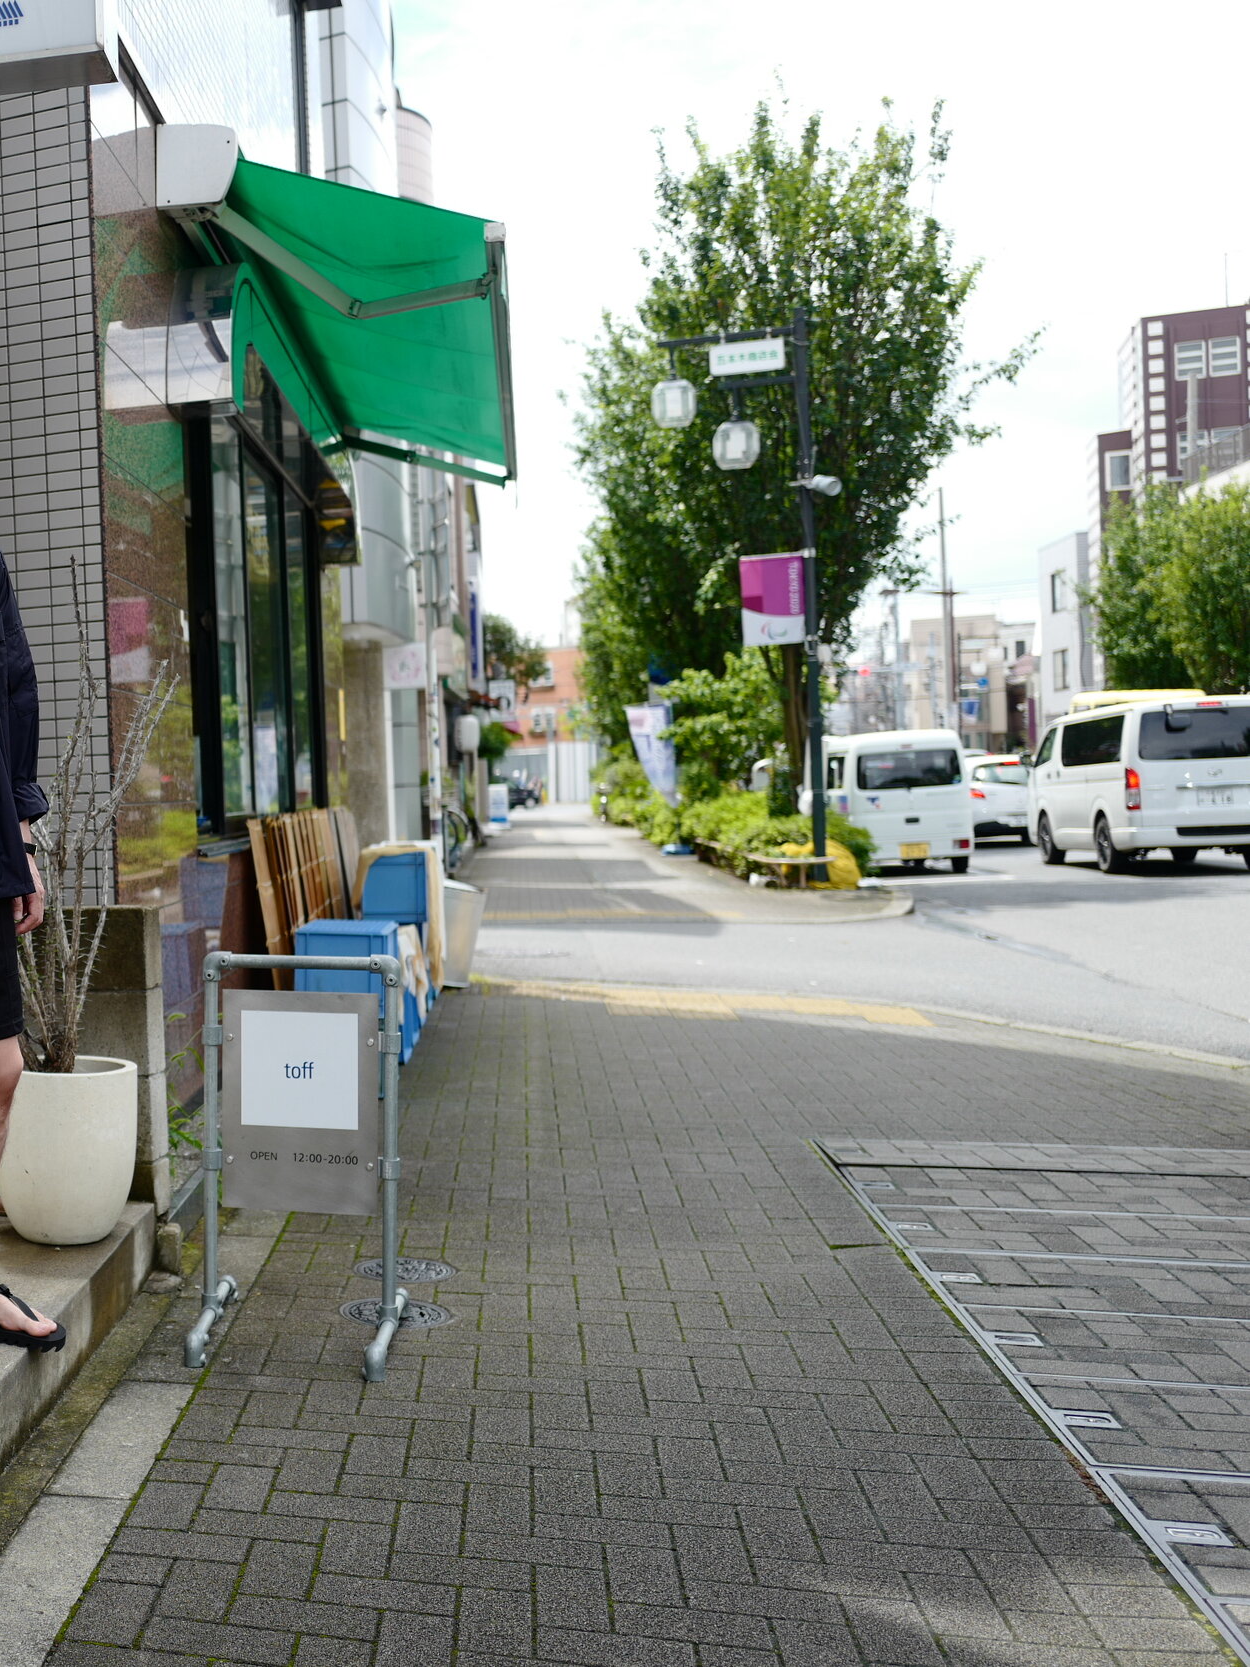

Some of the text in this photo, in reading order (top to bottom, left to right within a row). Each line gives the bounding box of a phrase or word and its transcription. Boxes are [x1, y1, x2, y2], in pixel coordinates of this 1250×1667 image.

[284, 1061, 314, 1079] toff
[250, 1151, 359, 1165] OPEN 12:00-20:00
